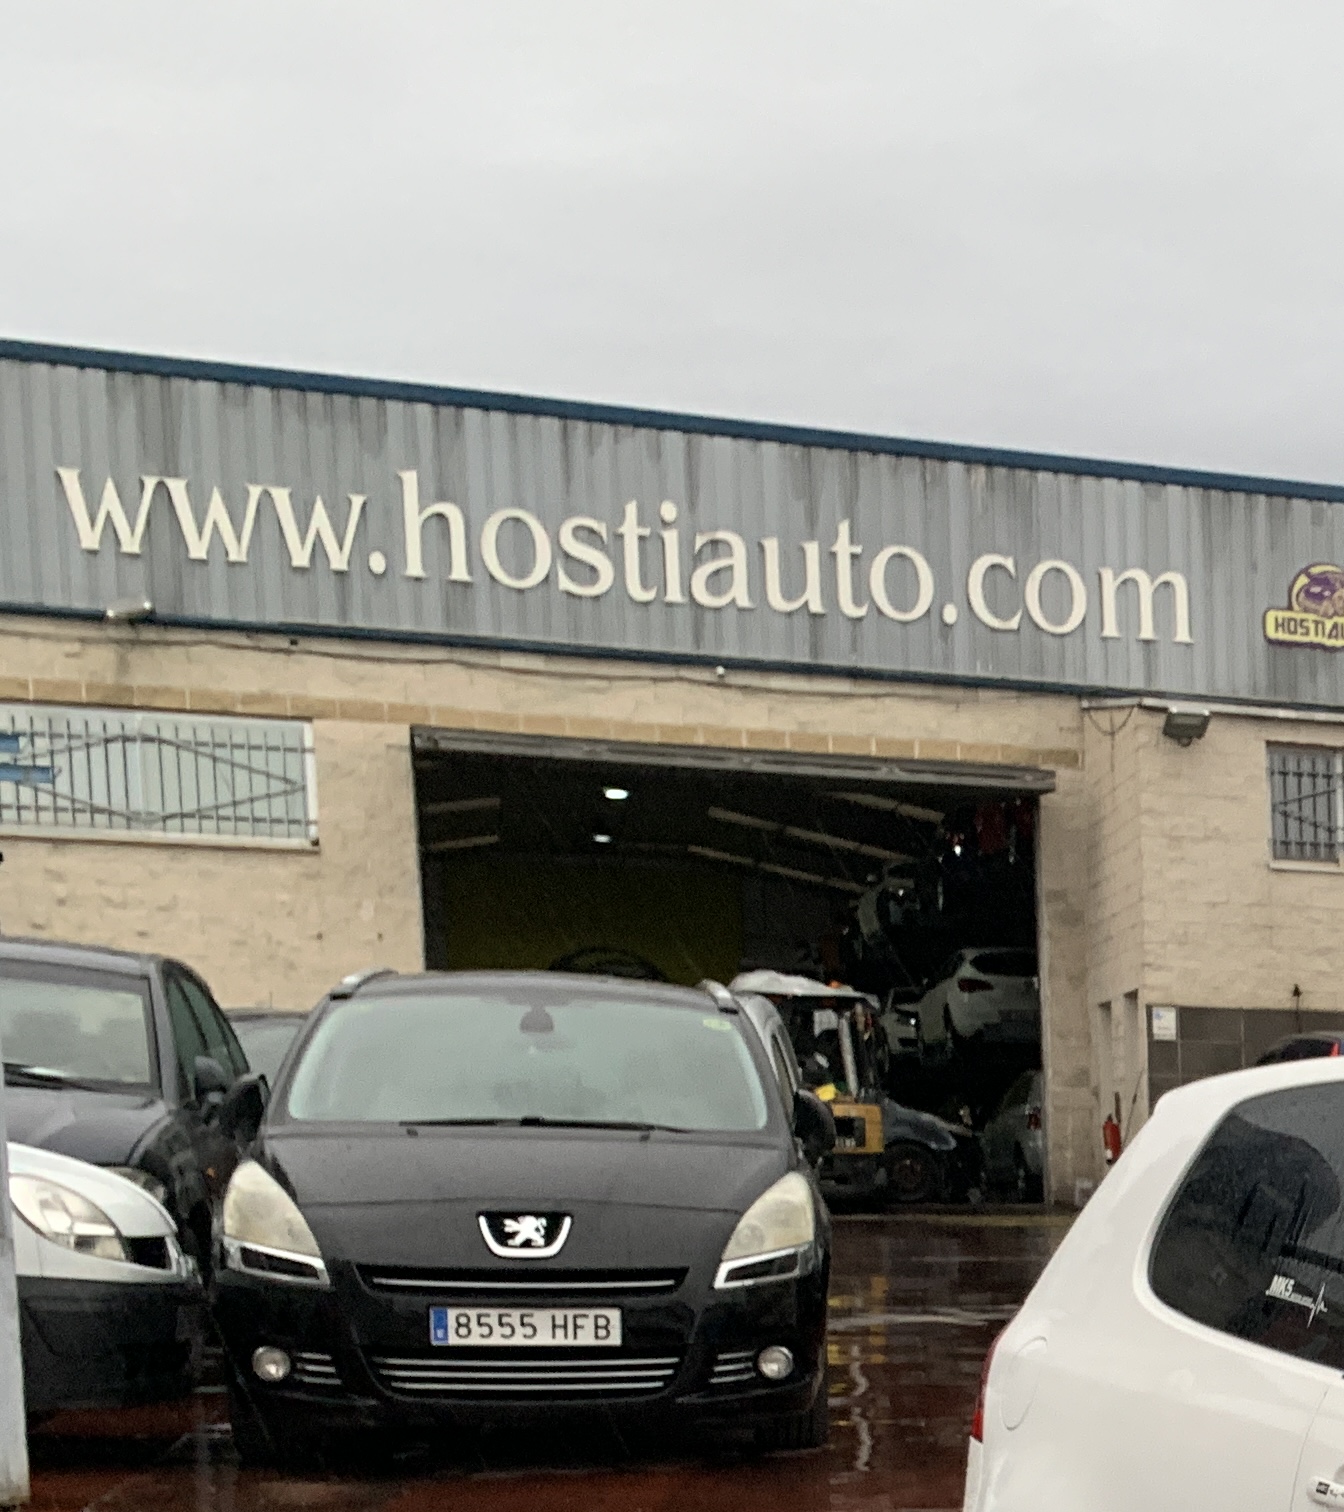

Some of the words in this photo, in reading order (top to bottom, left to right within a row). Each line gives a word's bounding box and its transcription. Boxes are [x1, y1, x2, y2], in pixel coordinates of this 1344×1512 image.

[56, 467, 1194, 644] www.hostiauto.com
[455, 1312, 537, 1339] 8555
[551, 1314, 611, 1341] HFB
